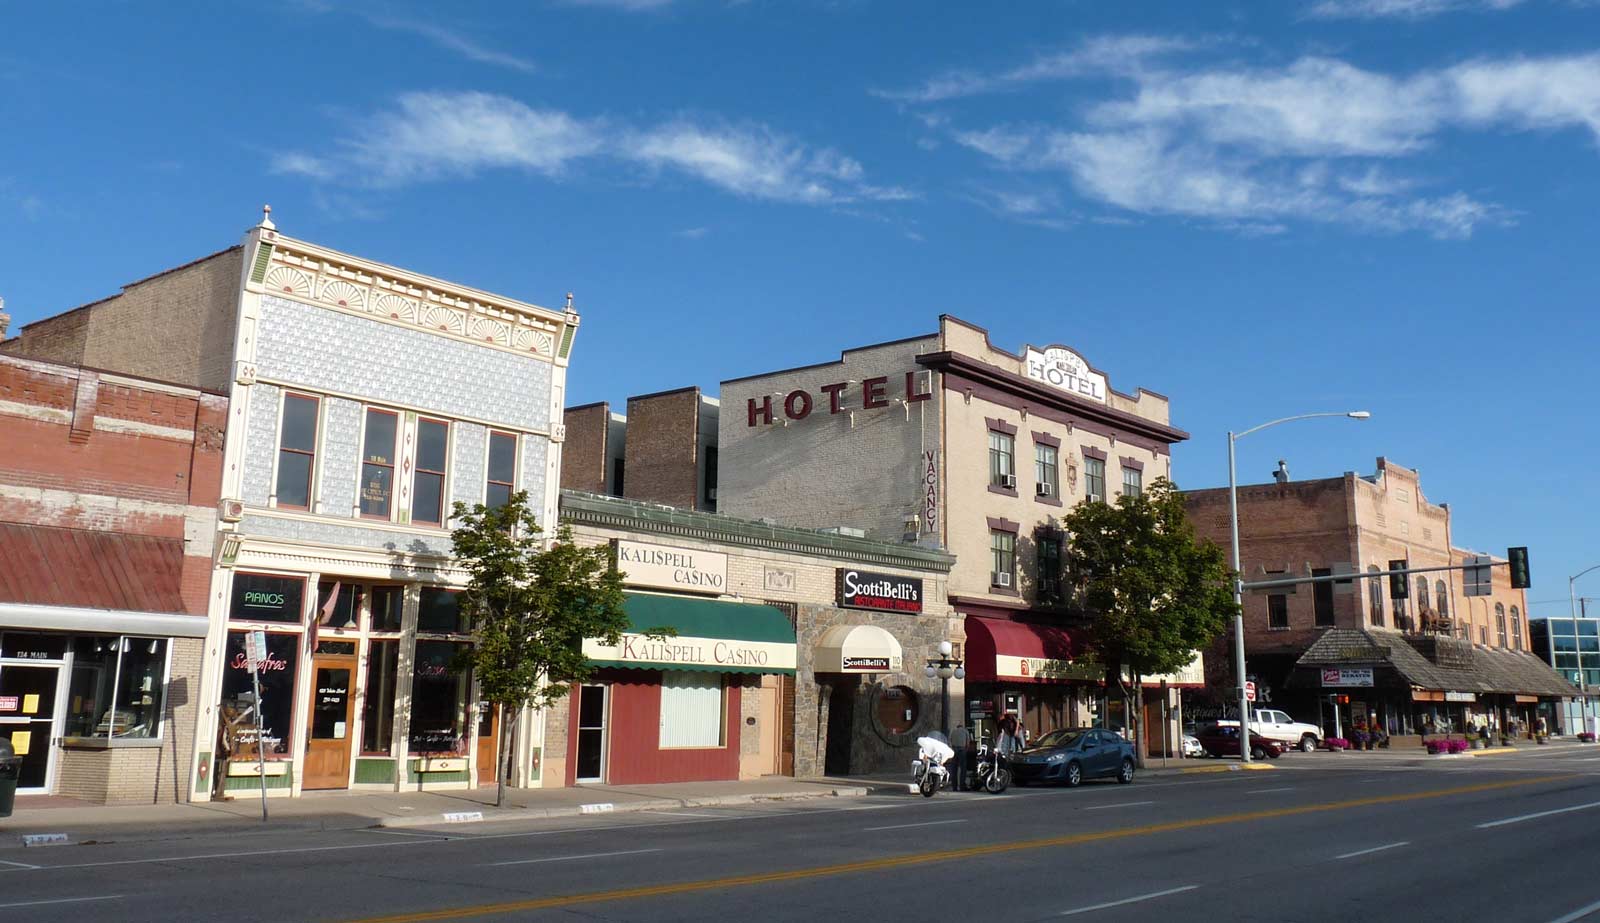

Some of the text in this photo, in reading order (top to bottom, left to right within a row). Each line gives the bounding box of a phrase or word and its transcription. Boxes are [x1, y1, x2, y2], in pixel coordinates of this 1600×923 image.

[1029, 360, 1103, 399] HOTEL
[747, 371, 932, 427] HOTEL
[926, 450, 936, 533] VACANCY
[245, 592, 284, 605] PIANOS
[845, 571, 917, 601] ScottiBelli's
[231, 652, 287, 674] Saafras
[844, 657, 887, 667] ScottiBelli's
